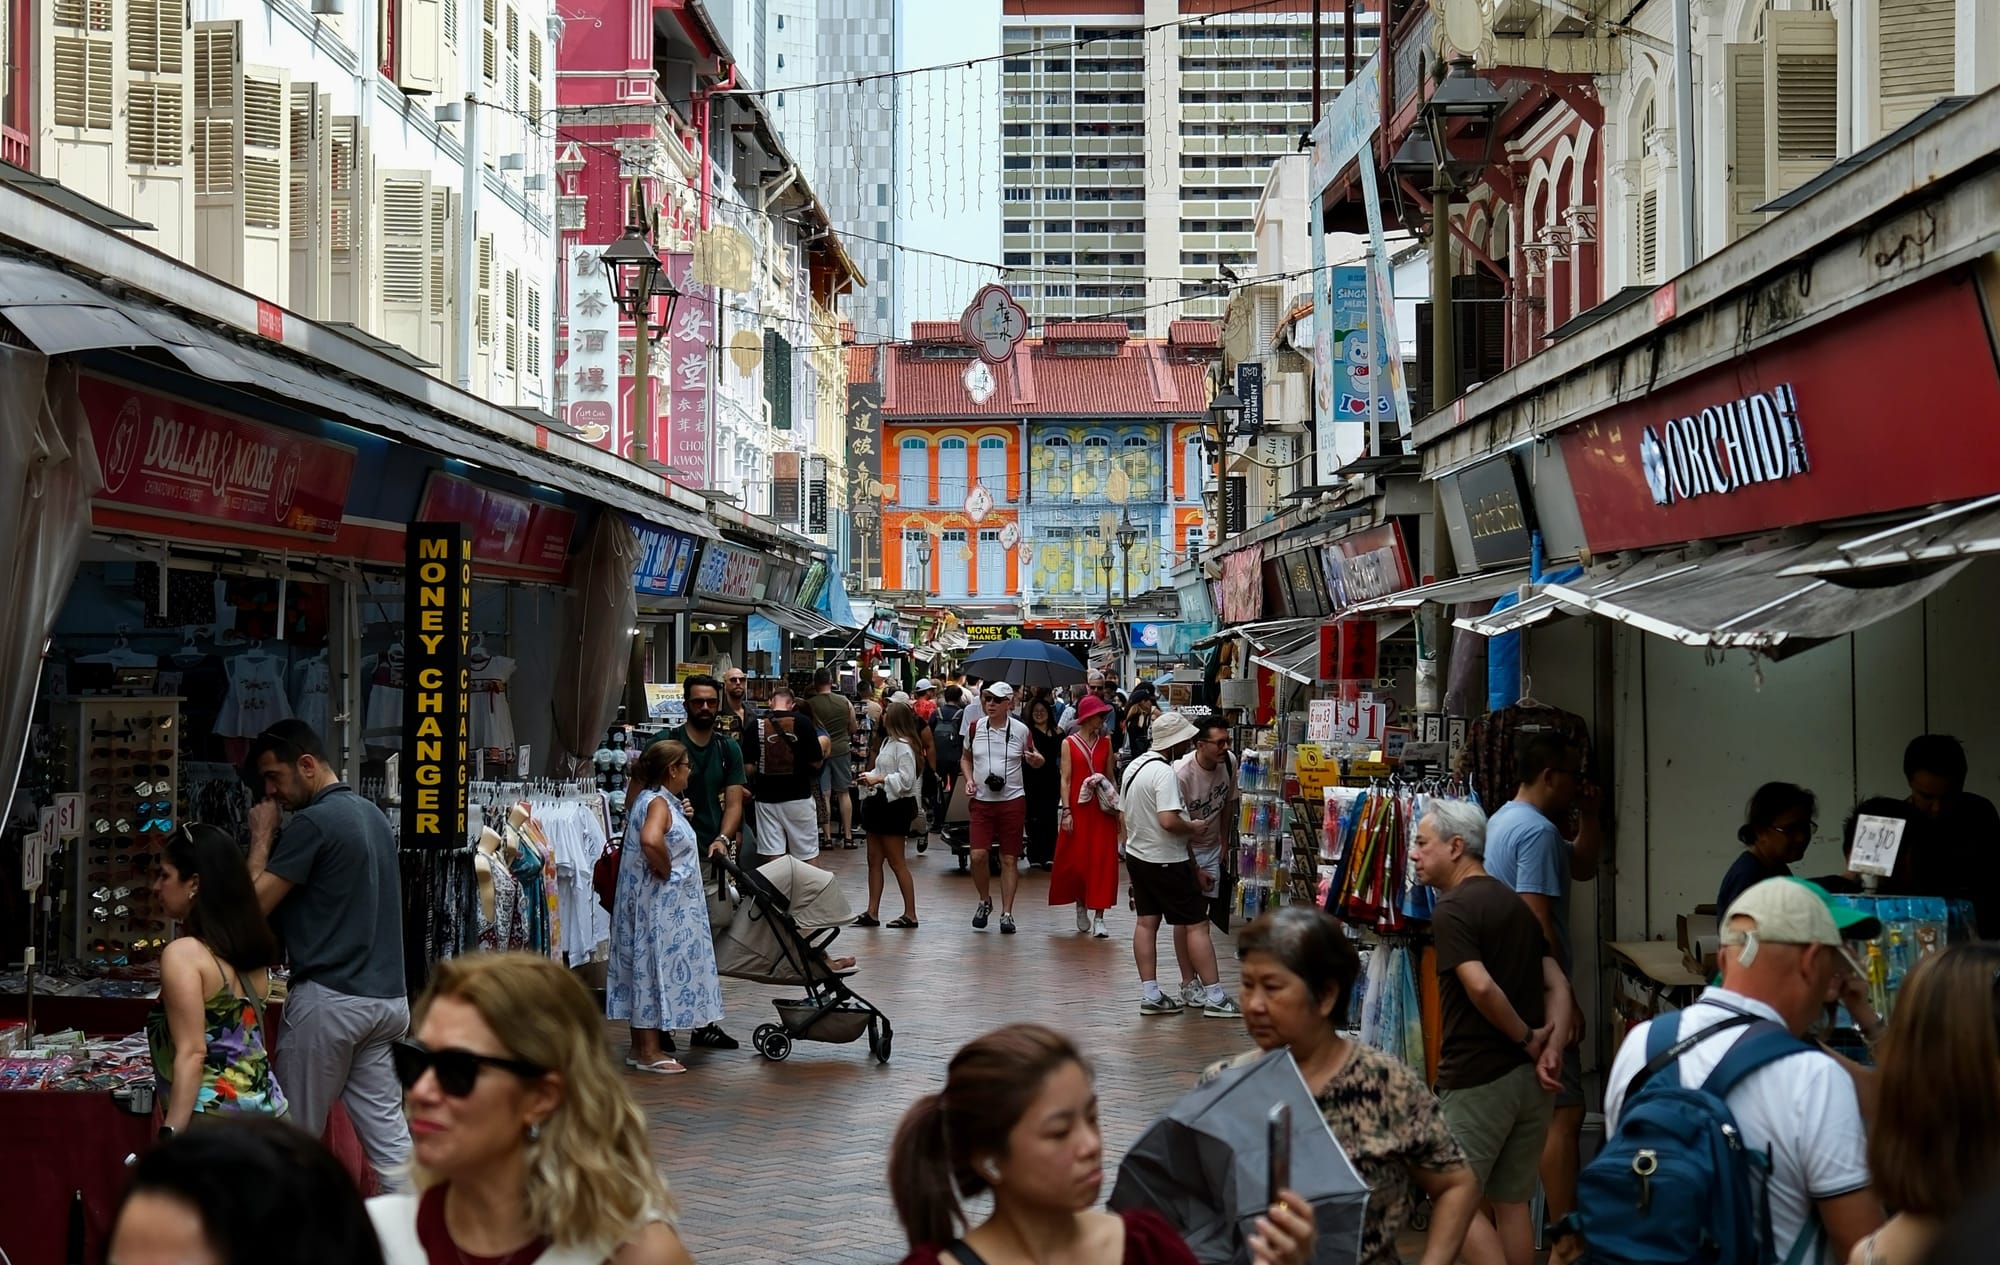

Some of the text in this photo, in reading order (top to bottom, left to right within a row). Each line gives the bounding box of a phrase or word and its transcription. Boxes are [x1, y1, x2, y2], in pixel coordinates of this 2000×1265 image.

[1251, 384, 1259, 424] OVEMENT
[144, 415, 279, 497] DOLLAR & MORE
[1666, 391, 1794, 498] ORCHID
[967, 626, 1002, 635] MONEY
[1053, 630, 1096, 640] TERRA
[415, 538, 448, 834] MONEY CHANGER
[457, 539, 471, 833] MONEY CHANGER
[1347, 704, 1380, 740] $1
